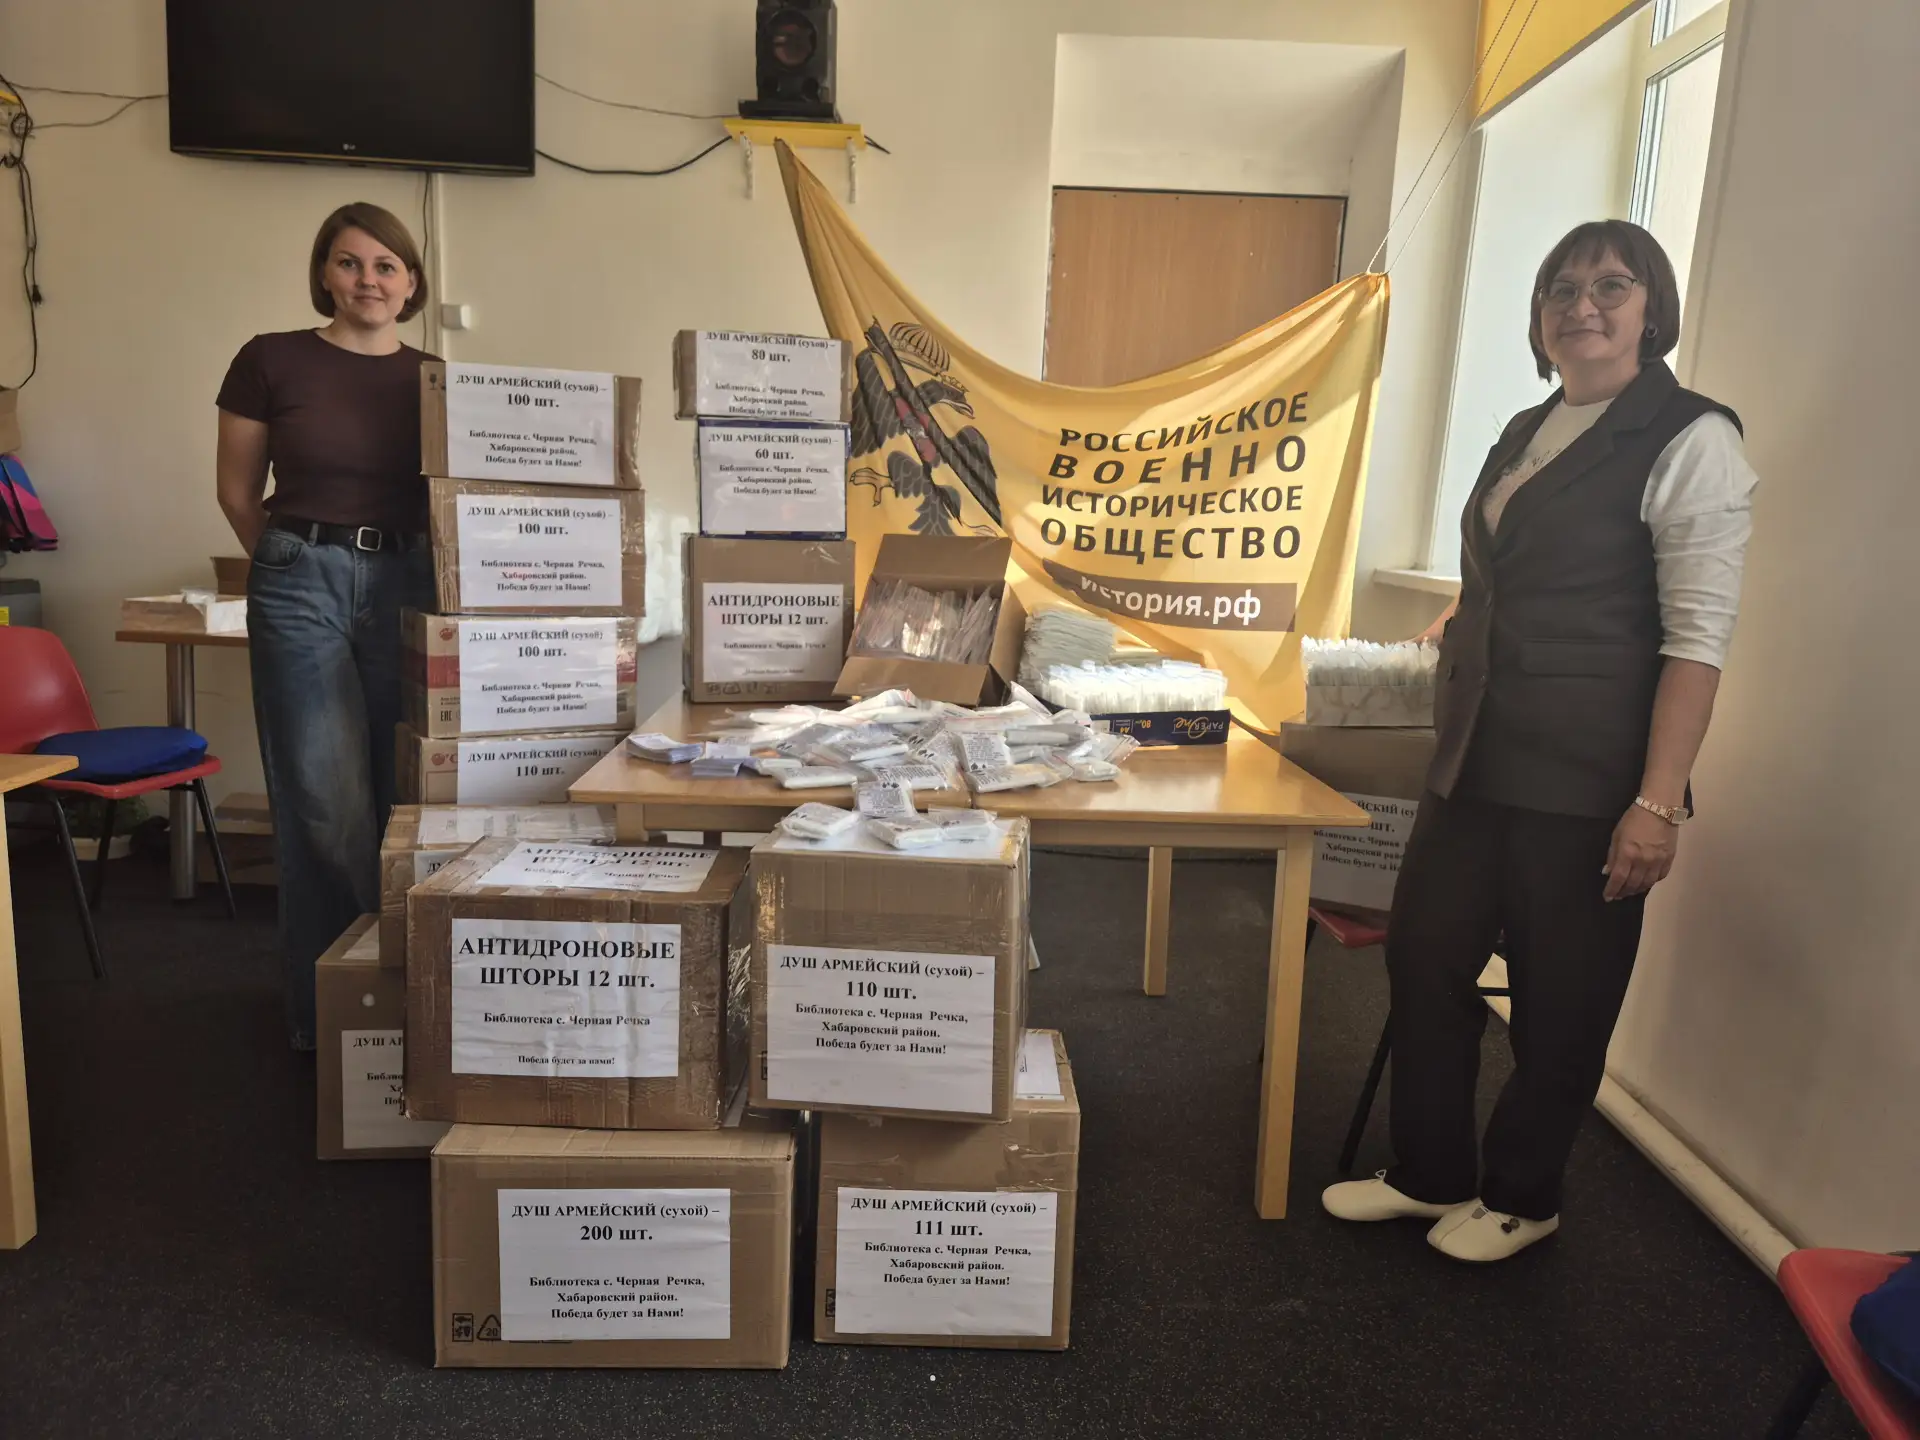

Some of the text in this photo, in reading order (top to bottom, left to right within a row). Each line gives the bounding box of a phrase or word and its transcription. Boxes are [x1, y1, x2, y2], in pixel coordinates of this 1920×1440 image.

[705, 331, 730, 341] ДУШ
[751, 349, 790, 362] 80 шт.
[456, 375, 599, 393] ДУШ АРМЕЙСКИЙ (сухой)
[508, 393, 559, 408] 100 шт.
[1060, 392, 1308, 452] РОССИЙСКОЕ
[469, 430, 521, 440] Библиотека
[532, 433, 565, 443] Черная
[708, 433, 832, 445] ДУШ АРМЕЙСКИЙ (сухой)
[489, 443, 547, 454] Хабаровский
[755, 448, 794, 460] 60 шт.
[485, 455, 517, 464] Победа
[518, 456, 541, 466] будет
[1048, 436, 1306, 484] ВОЕННО
[1042, 484, 1303, 518] ИСТОРИЧЕСКОЕ
[467, 507, 606, 520] ДУШ АРМЕЙСКИЙ (сухой)
[519, 523, 569, 535] 100 шт.
[1040, 518, 1300, 564] ОБЩЕСТВО
[481, 559, 533, 568] Библиотека
[501, 571, 558, 581] Хабаровский
[708, 595, 840, 608] АНТИДРОНОВЫЕ
[722, 613, 828, 625] ШТОРЫ 12 шт.
[469, 632, 497, 642] ДУШ
[500, 629, 569, 640] АРМЕЙСКИЙ
[519, 646, 567, 657] 100 шт.
[468, 752, 495, 763] ДУШ
[499, 748, 568, 760] АРМЕЙСКИЙ
[517, 765, 564, 777] 110 шт.
[459, 938, 675, 960] АНТИДРОНОВЫЕ
[780, 956, 973, 979] ДУШ АРМЕЙСКИЙ (сухой)
[481, 967, 655, 988] ШТОРЫ 12 шт.
[848, 981, 917, 1000] 110 шт.
[484, 1012, 650, 1028] Библиотека с. Черная Речка
[796, 1003, 968, 1023] Библиотека с. Черная Речка,
[822, 1021, 940, 1038] Хабаровский район.
[353, 1037, 385, 1048] ДУШ
[816, 1037, 856, 1049] Победа
[859, 1040, 890, 1053] будет
[910, 1043, 946, 1054] Нами!
[518, 1055, 549, 1064] Победа
[551, 1055, 575, 1066] будет
[511, 1203, 708, 1219] ДУШ АРМЕЙСКИЙ (сухой)
[850, 1197, 1036, 1215] ДУШ АРМЕЙСКИЙ (сухой)
[580, 1225, 653, 1241] 200 шт.
[916, 1220, 983, 1236] 111 шт.
[865, 1242, 931, 1254] Библиотека
[947, 1245, 988, 1257] Черная
[995, 1245, 1031, 1256] Речка,
[890, 1258, 1005, 1272] Хабаровский район.
[530, 1277, 600, 1287] Библиотека
[616, 1276, 659, 1288] Черная
[667, 1276, 705, 1286] Речка,
[884, 1273, 924, 1284] Победа
[926, 1275, 956, 1287] будет
[975, 1276, 1010, 1285] Нами!
[557, 1292, 678, 1305] Хабаровский район.
[551, 1308, 593, 1319] Победа
[596, 1308, 628, 1321] будет
[647, 1308, 684, 1318] Нами!
